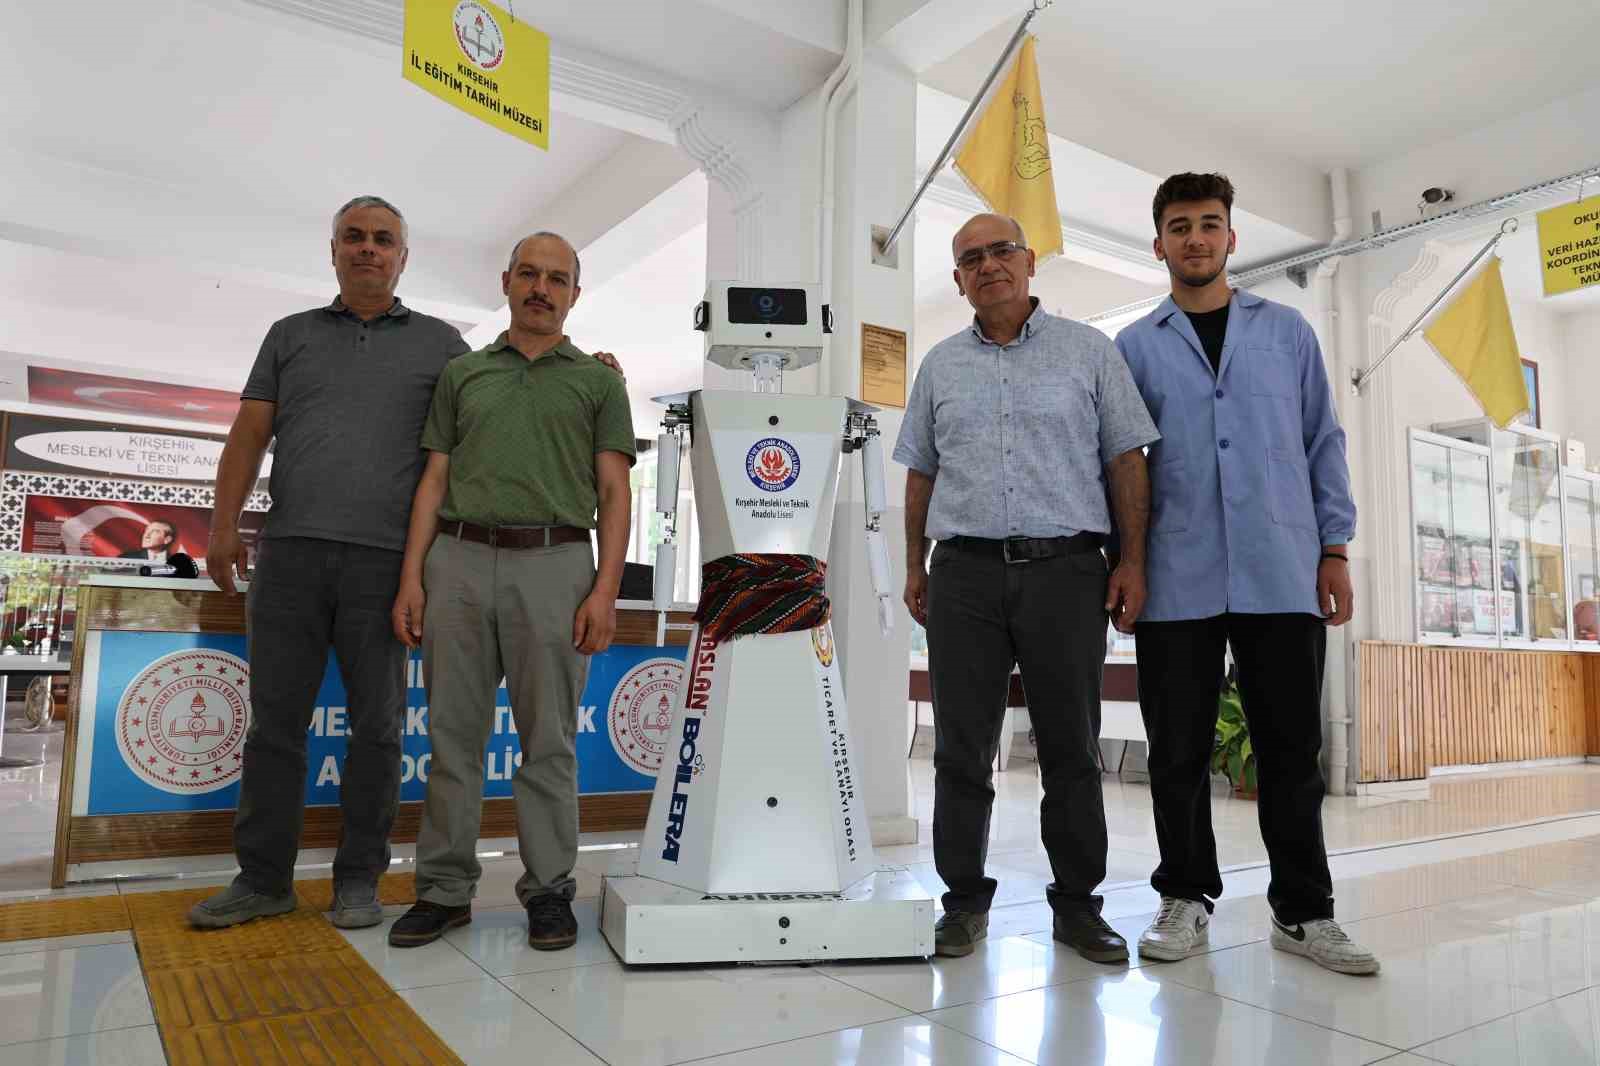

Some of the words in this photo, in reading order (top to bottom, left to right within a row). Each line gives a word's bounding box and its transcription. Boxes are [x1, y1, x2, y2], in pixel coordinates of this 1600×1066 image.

[457, 63, 499, 93] KIRŞEHİR
[411, 49, 422, 71] İL
[424, 60, 462, 93] EĞİTİM
[465, 84, 501, 113] TARİHİ
[503, 104, 542, 133] MÜZESİ
[1547, 241, 1573, 257] VERİ
[129, 435, 195, 451] KIRŞEHİR
[47, 442, 112, 458] MESLEKİ
[116, 449, 135, 461] VE
[141, 450, 192, 465] TEKNİK
[136, 462, 180, 476] LİSESİ
[735, 498, 758, 509] Kırşehir
[759, 498, 781, 508] Mesleki
[782, 500, 789, 508] ve
[790, 499, 809, 509] Teknik
[751, 509, 776, 519] Anadolu
[777, 510, 794, 519] Lisesi
[822, 676, 837, 735] TİCARET
[844, 817, 856, 861] ODASI
